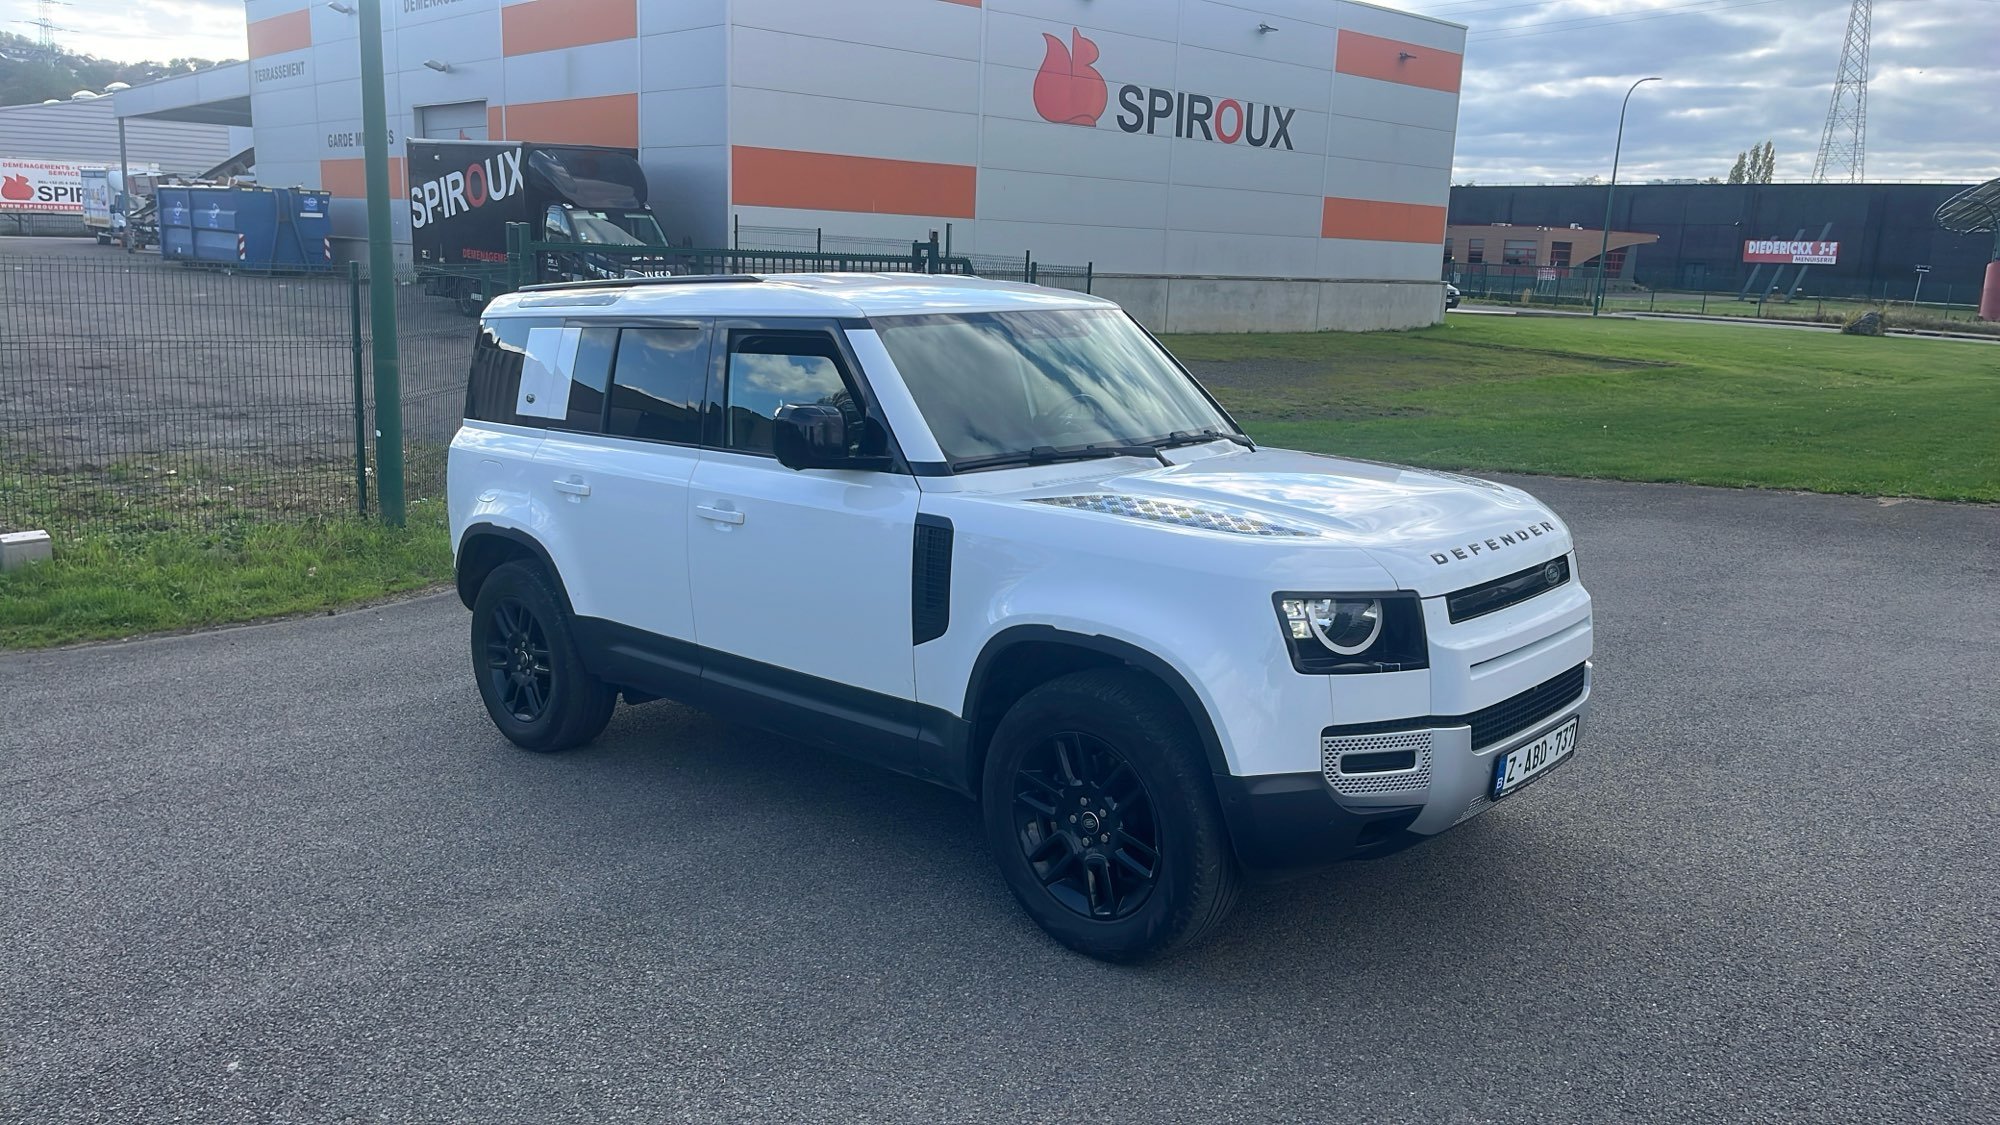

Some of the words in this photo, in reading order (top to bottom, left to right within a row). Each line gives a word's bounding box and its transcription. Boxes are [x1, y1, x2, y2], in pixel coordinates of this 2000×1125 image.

[255, 61, 305, 83] TERRASSEMENT
[1117, 84, 1296, 150] SPIROUX
[328, 133, 353, 148] GARDE
[411, 147, 524, 228] SPIROUX
[1748, 240, 1813, 255] DIEDERICKX
[462, 248, 509, 263] DEMENAGEME
[644, 270, 672, 279] IVECO
[1430, 521, 1555, 565] DEFENDER
[1496, 777, 1504, 789] B
